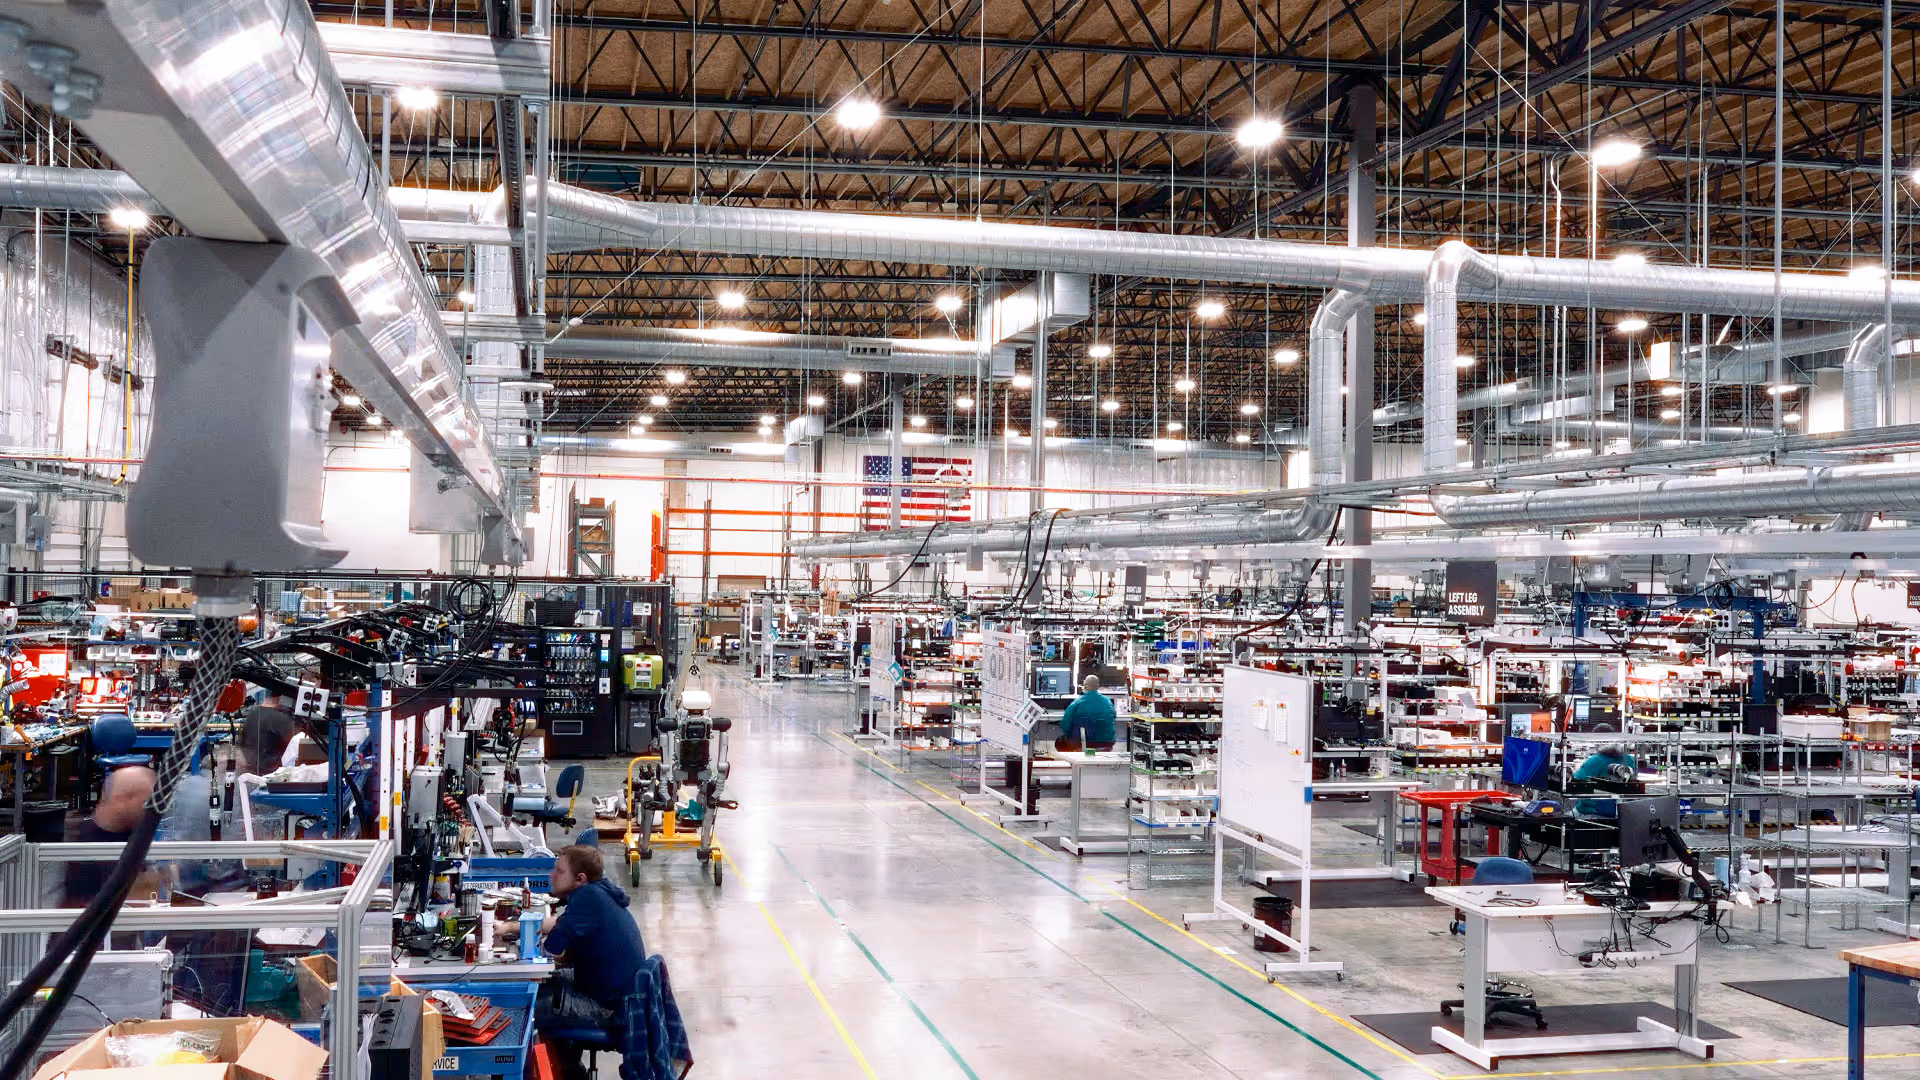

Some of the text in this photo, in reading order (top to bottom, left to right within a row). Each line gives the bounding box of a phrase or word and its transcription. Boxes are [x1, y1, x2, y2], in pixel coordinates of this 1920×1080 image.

[1448, 592, 1478, 603] LEFT LEG
[1448, 604, 1485, 616] ASSEMBLY
